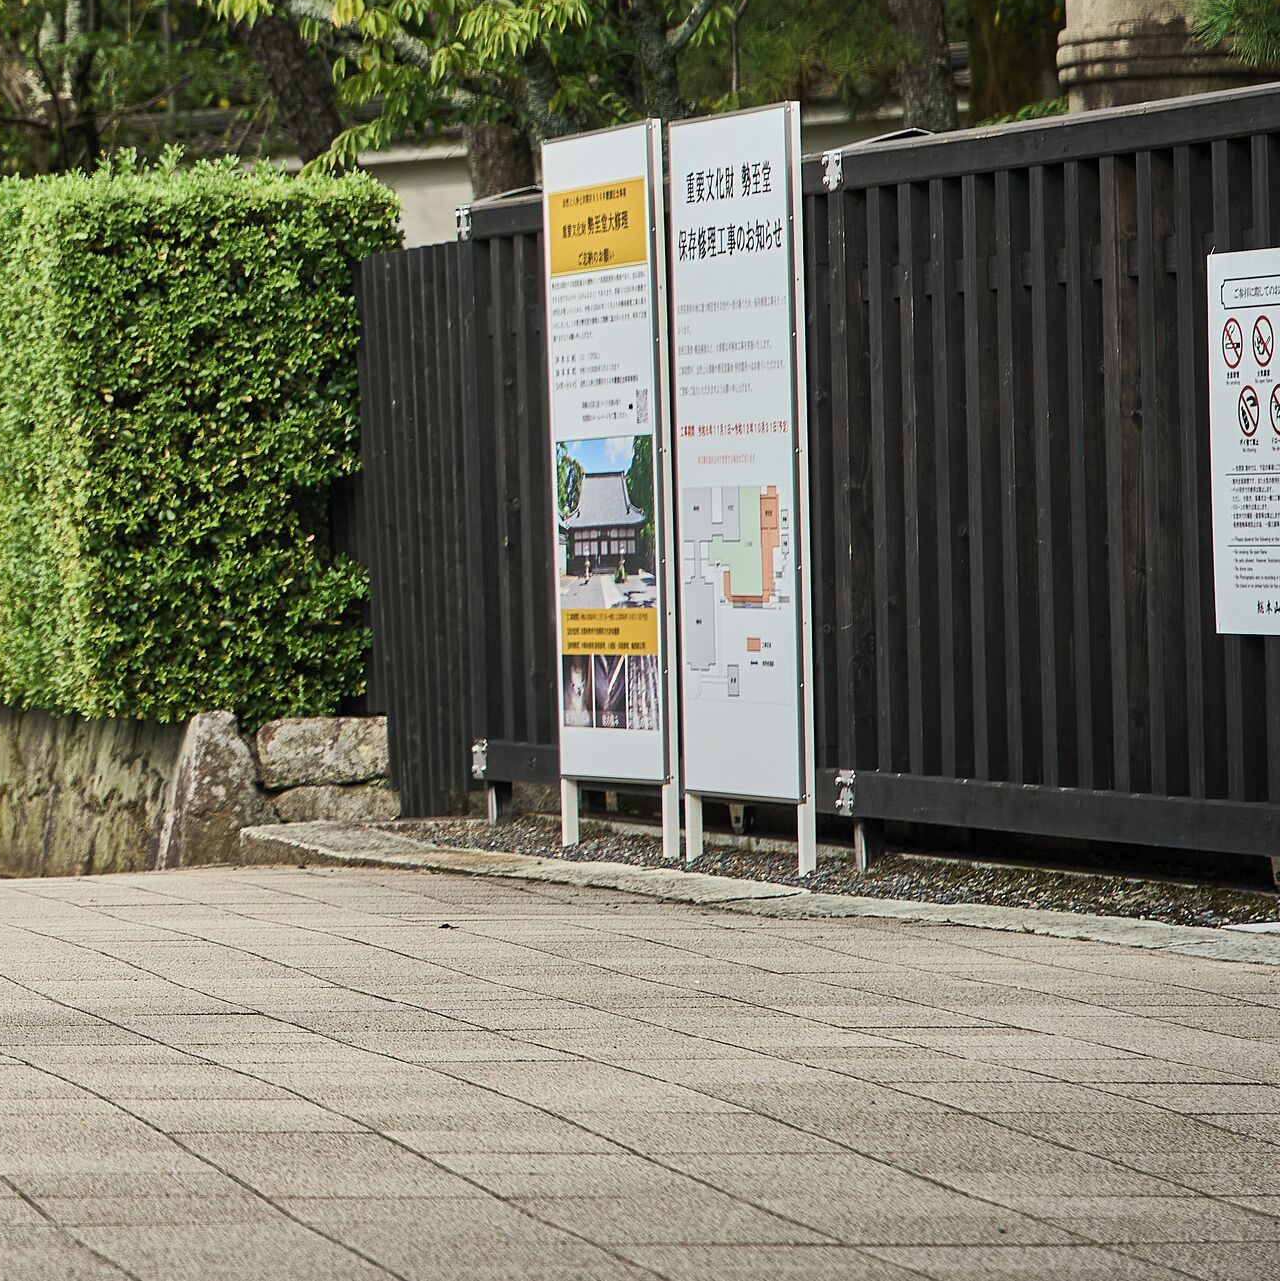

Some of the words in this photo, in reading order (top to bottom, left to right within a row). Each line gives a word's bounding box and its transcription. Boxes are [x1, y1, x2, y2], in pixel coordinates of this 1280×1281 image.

[686, 165, 735, 204] 重要文化財
[741, 160, 772, 198] 勢至堂
[678, 217, 783, 262] 保存修理工事のお知らせ
